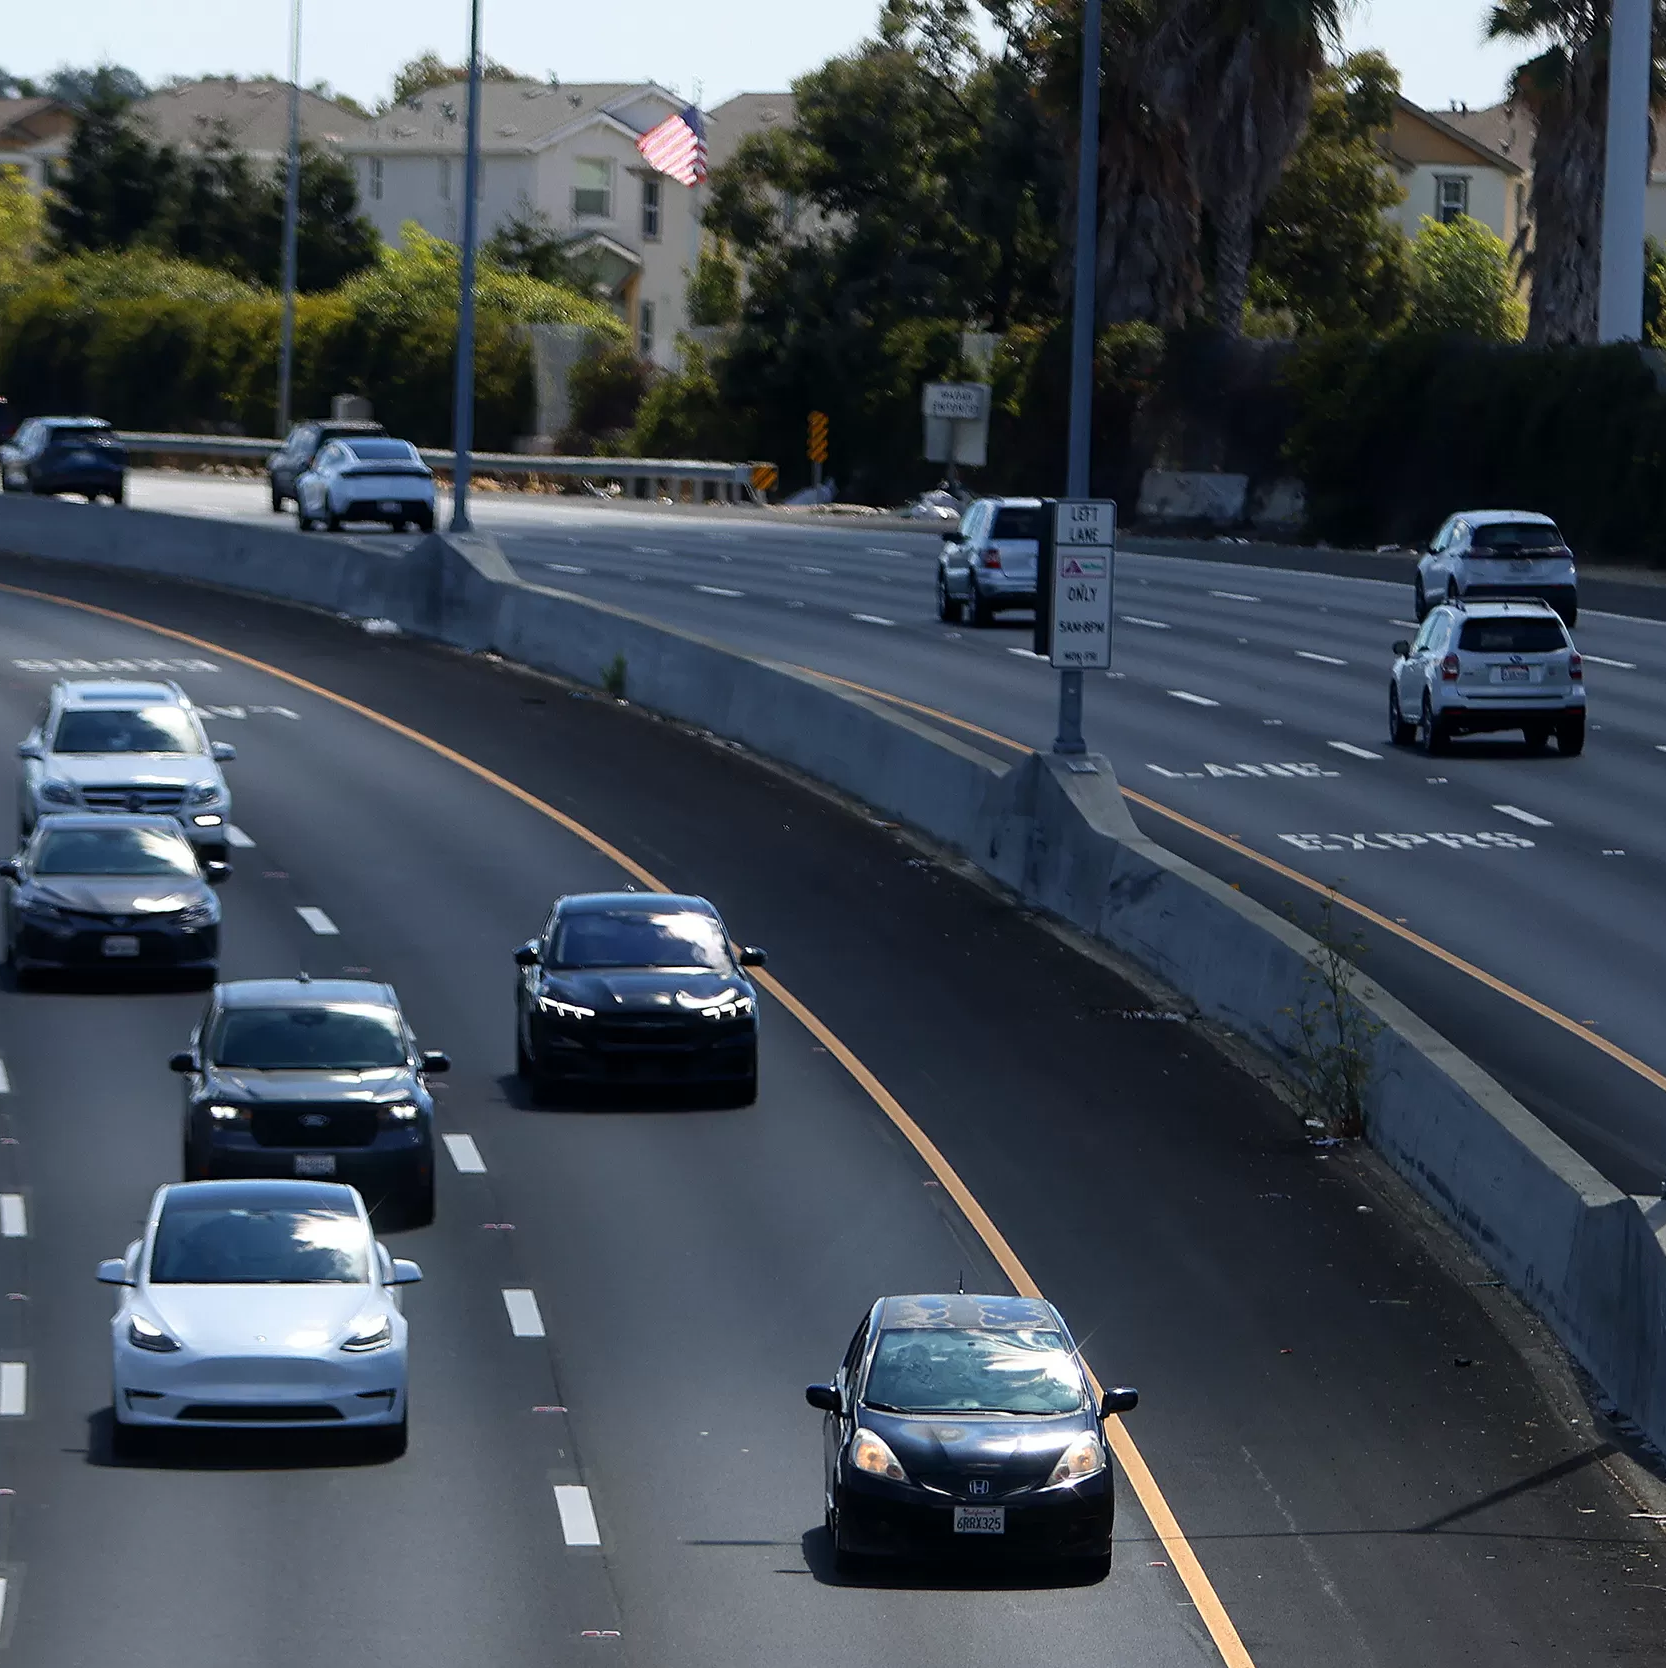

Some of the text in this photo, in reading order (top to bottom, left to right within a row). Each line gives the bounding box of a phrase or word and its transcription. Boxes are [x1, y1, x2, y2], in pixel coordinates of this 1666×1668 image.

[1071, 505, 1099, 522] LEFT
[1069, 527, 1100, 543] LANE
[1067, 585, 1098, 602] ONLY
[1144, 762, 1341, 779] LANE
[1276, 831, 1536, 852] EXPRS
[956, 1516, 1001, 1530] 6RRX325
